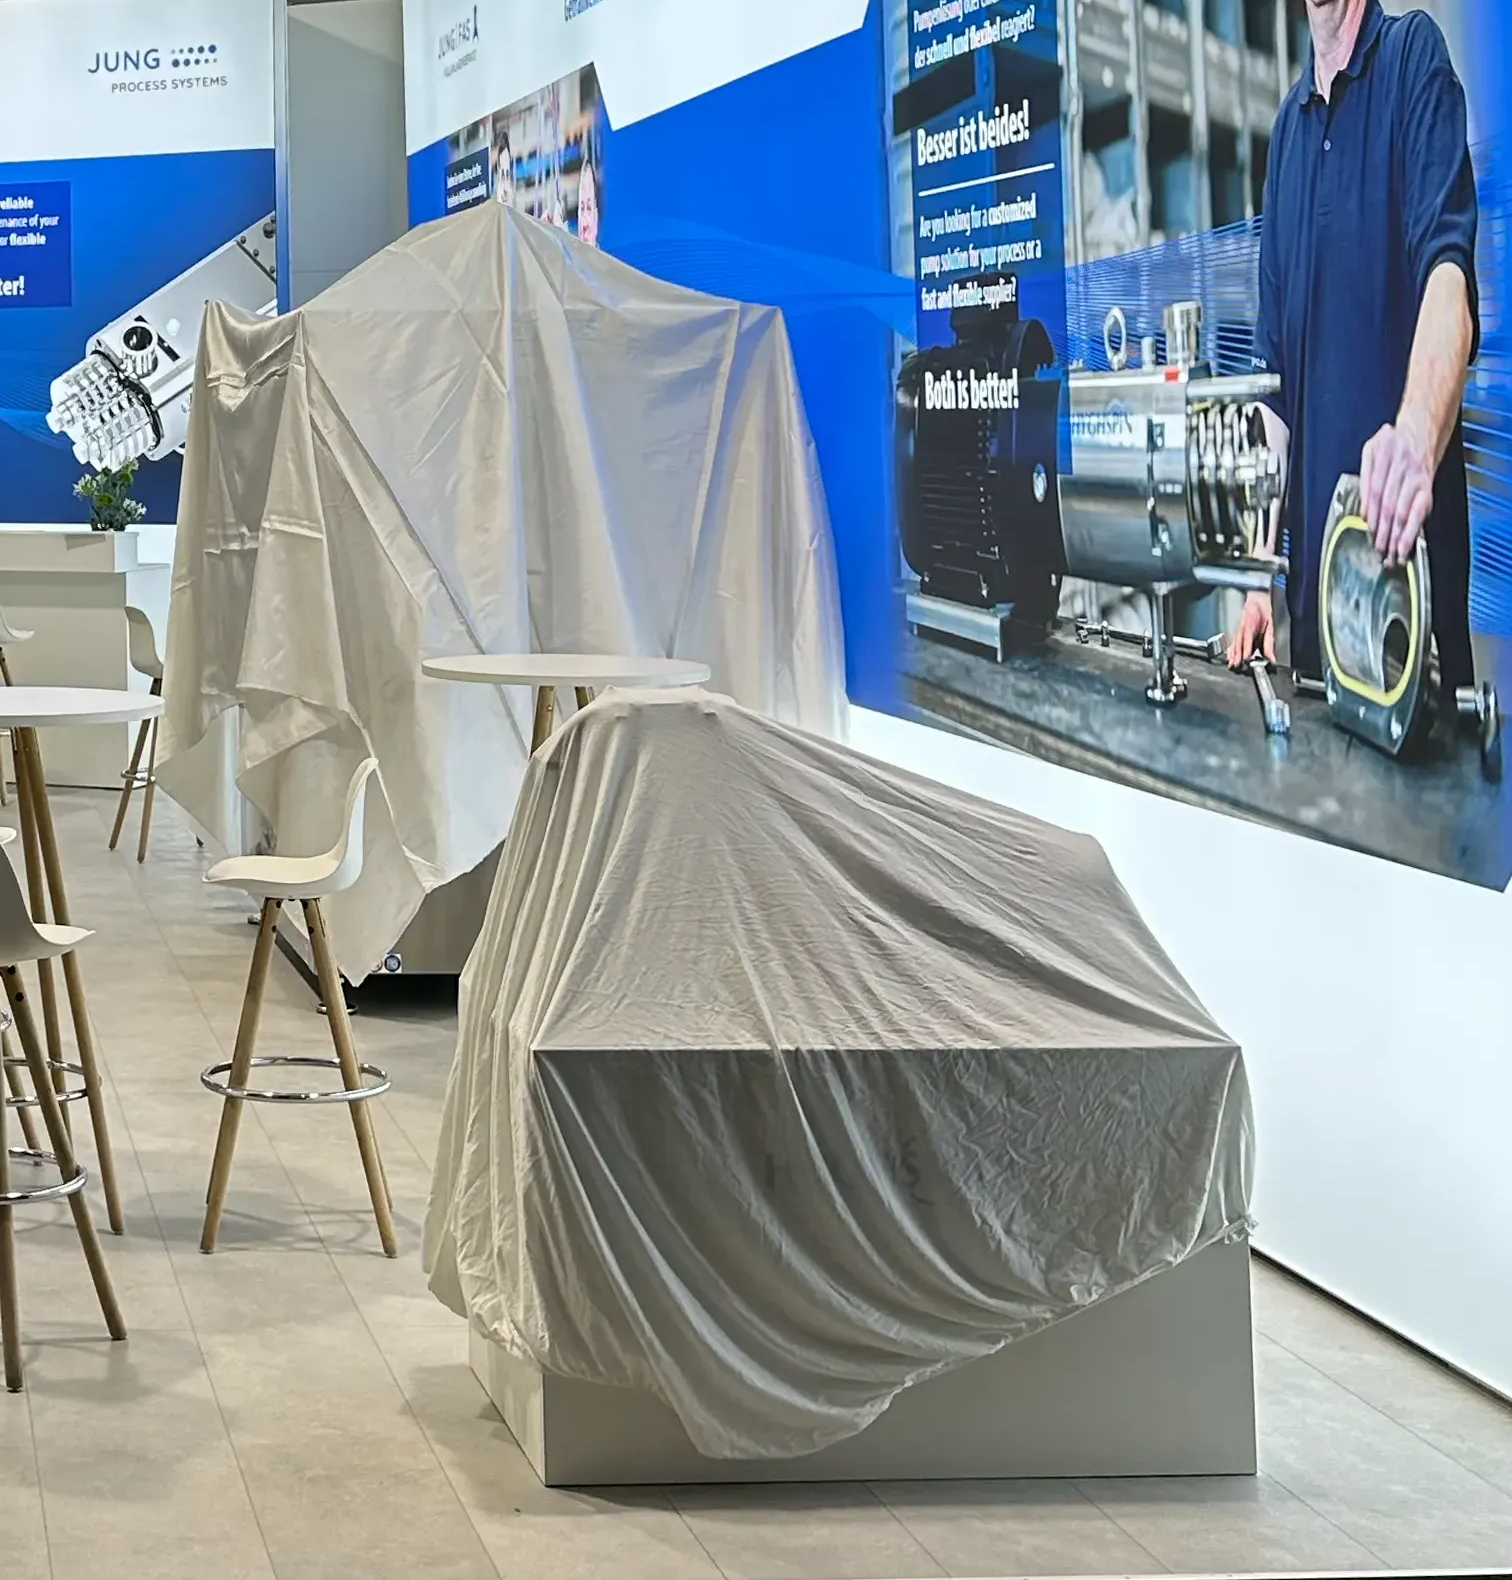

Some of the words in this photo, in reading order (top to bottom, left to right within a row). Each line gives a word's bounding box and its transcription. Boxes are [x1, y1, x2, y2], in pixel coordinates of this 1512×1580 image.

[87, 48, 160, 73] JUNG
[111, 80, 167, 93] PROCESS
[171, 76, 228, 90] SYSTEMS
[916, 127, 958, 166] Besser
[959, 115, 977, 156] ist
[978, 99, 1030, 151] beides!
[29, 214, 39, 227] of
[39, 215, 59, 229] your
[9, 232, 47, 246] flexible
[924, 370, 957, 410] Both
[957, 369, 969, 410] is
[969, 367, 1019, 410] better!
